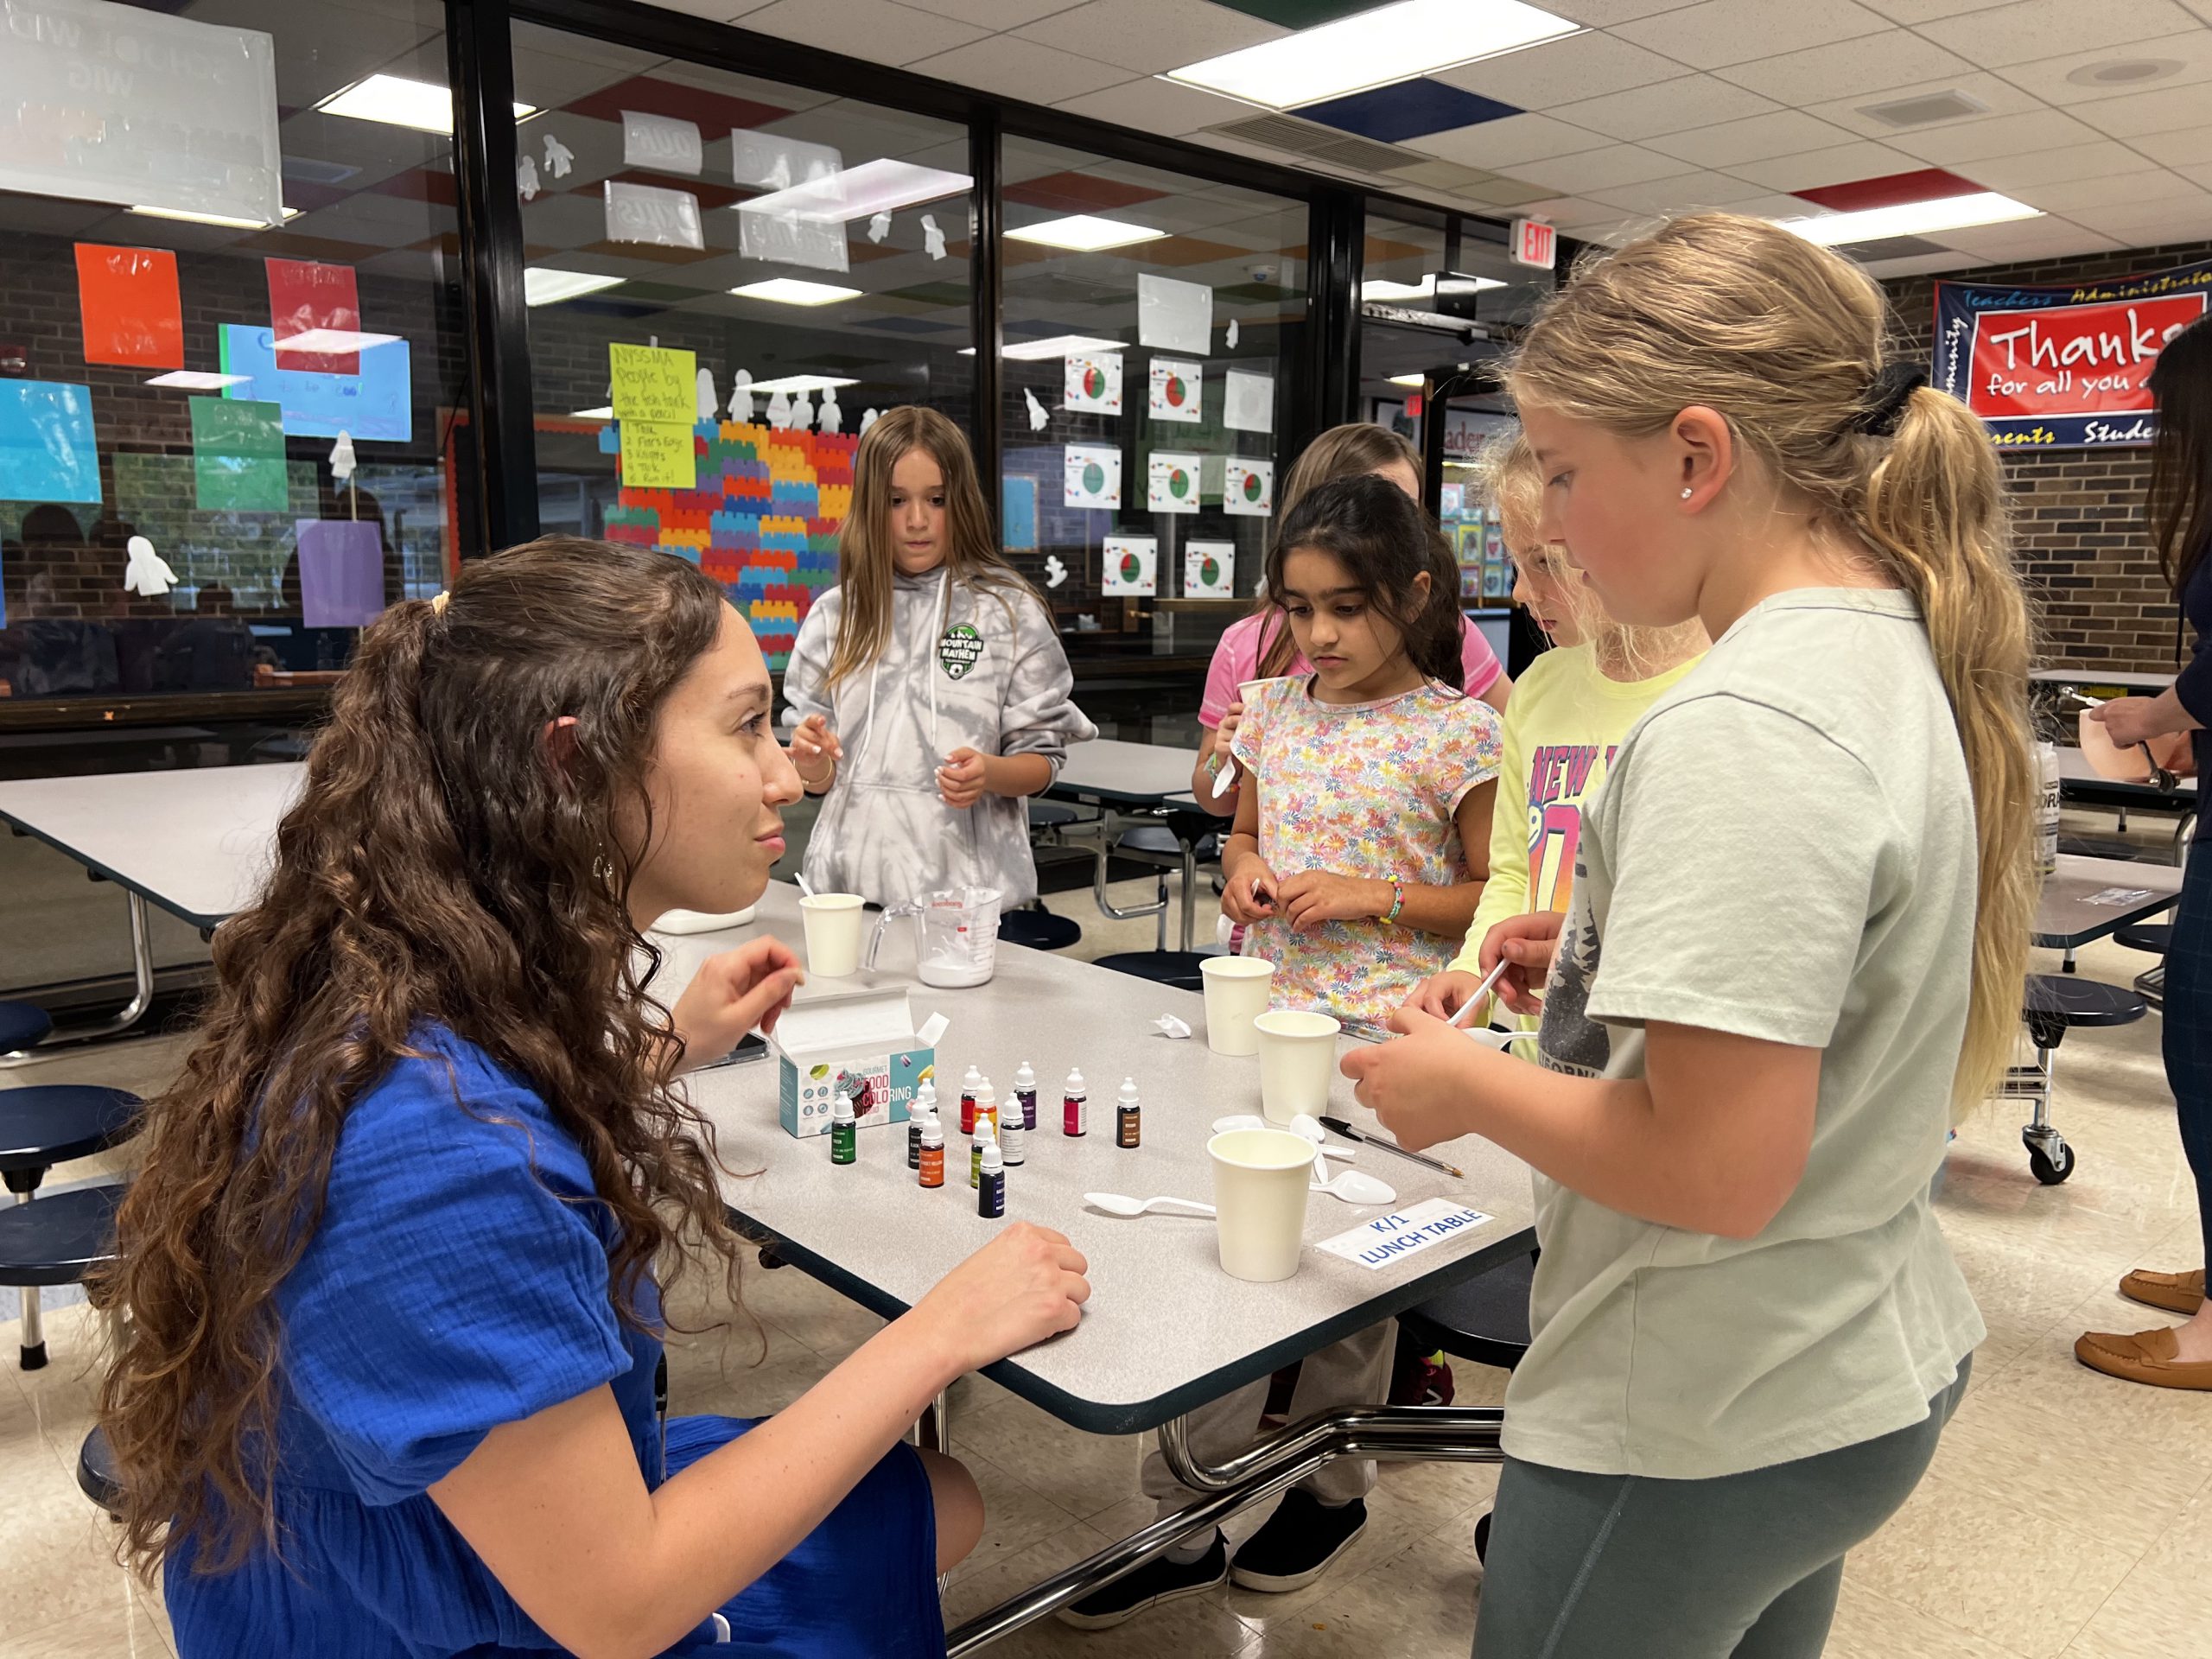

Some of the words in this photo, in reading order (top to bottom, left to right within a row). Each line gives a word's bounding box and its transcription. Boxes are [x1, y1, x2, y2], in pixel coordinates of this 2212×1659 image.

[1524, 223, 1553, 264] EXIT
[1963, 289, 2054, 308] Teachers
[1987, 373, 2028, 397] for
[2037, 370, 2072, 394] all
[2082, 374, 2130, 399] you
[1990, 427, 2055, 445] rents
[2084, 419, 2160, 443] Stude
[1529, 745, 1599, 804] NEW
[863, 1074, 888, 1090] FOOD
[862, 1085, 912, 1106] COLORING
[1359, 1231, 1429, 1264] LUNCH
[1421, 1209, 1483, 1236] TABLE
[1369, 1215, 1410, 1233] K/1
